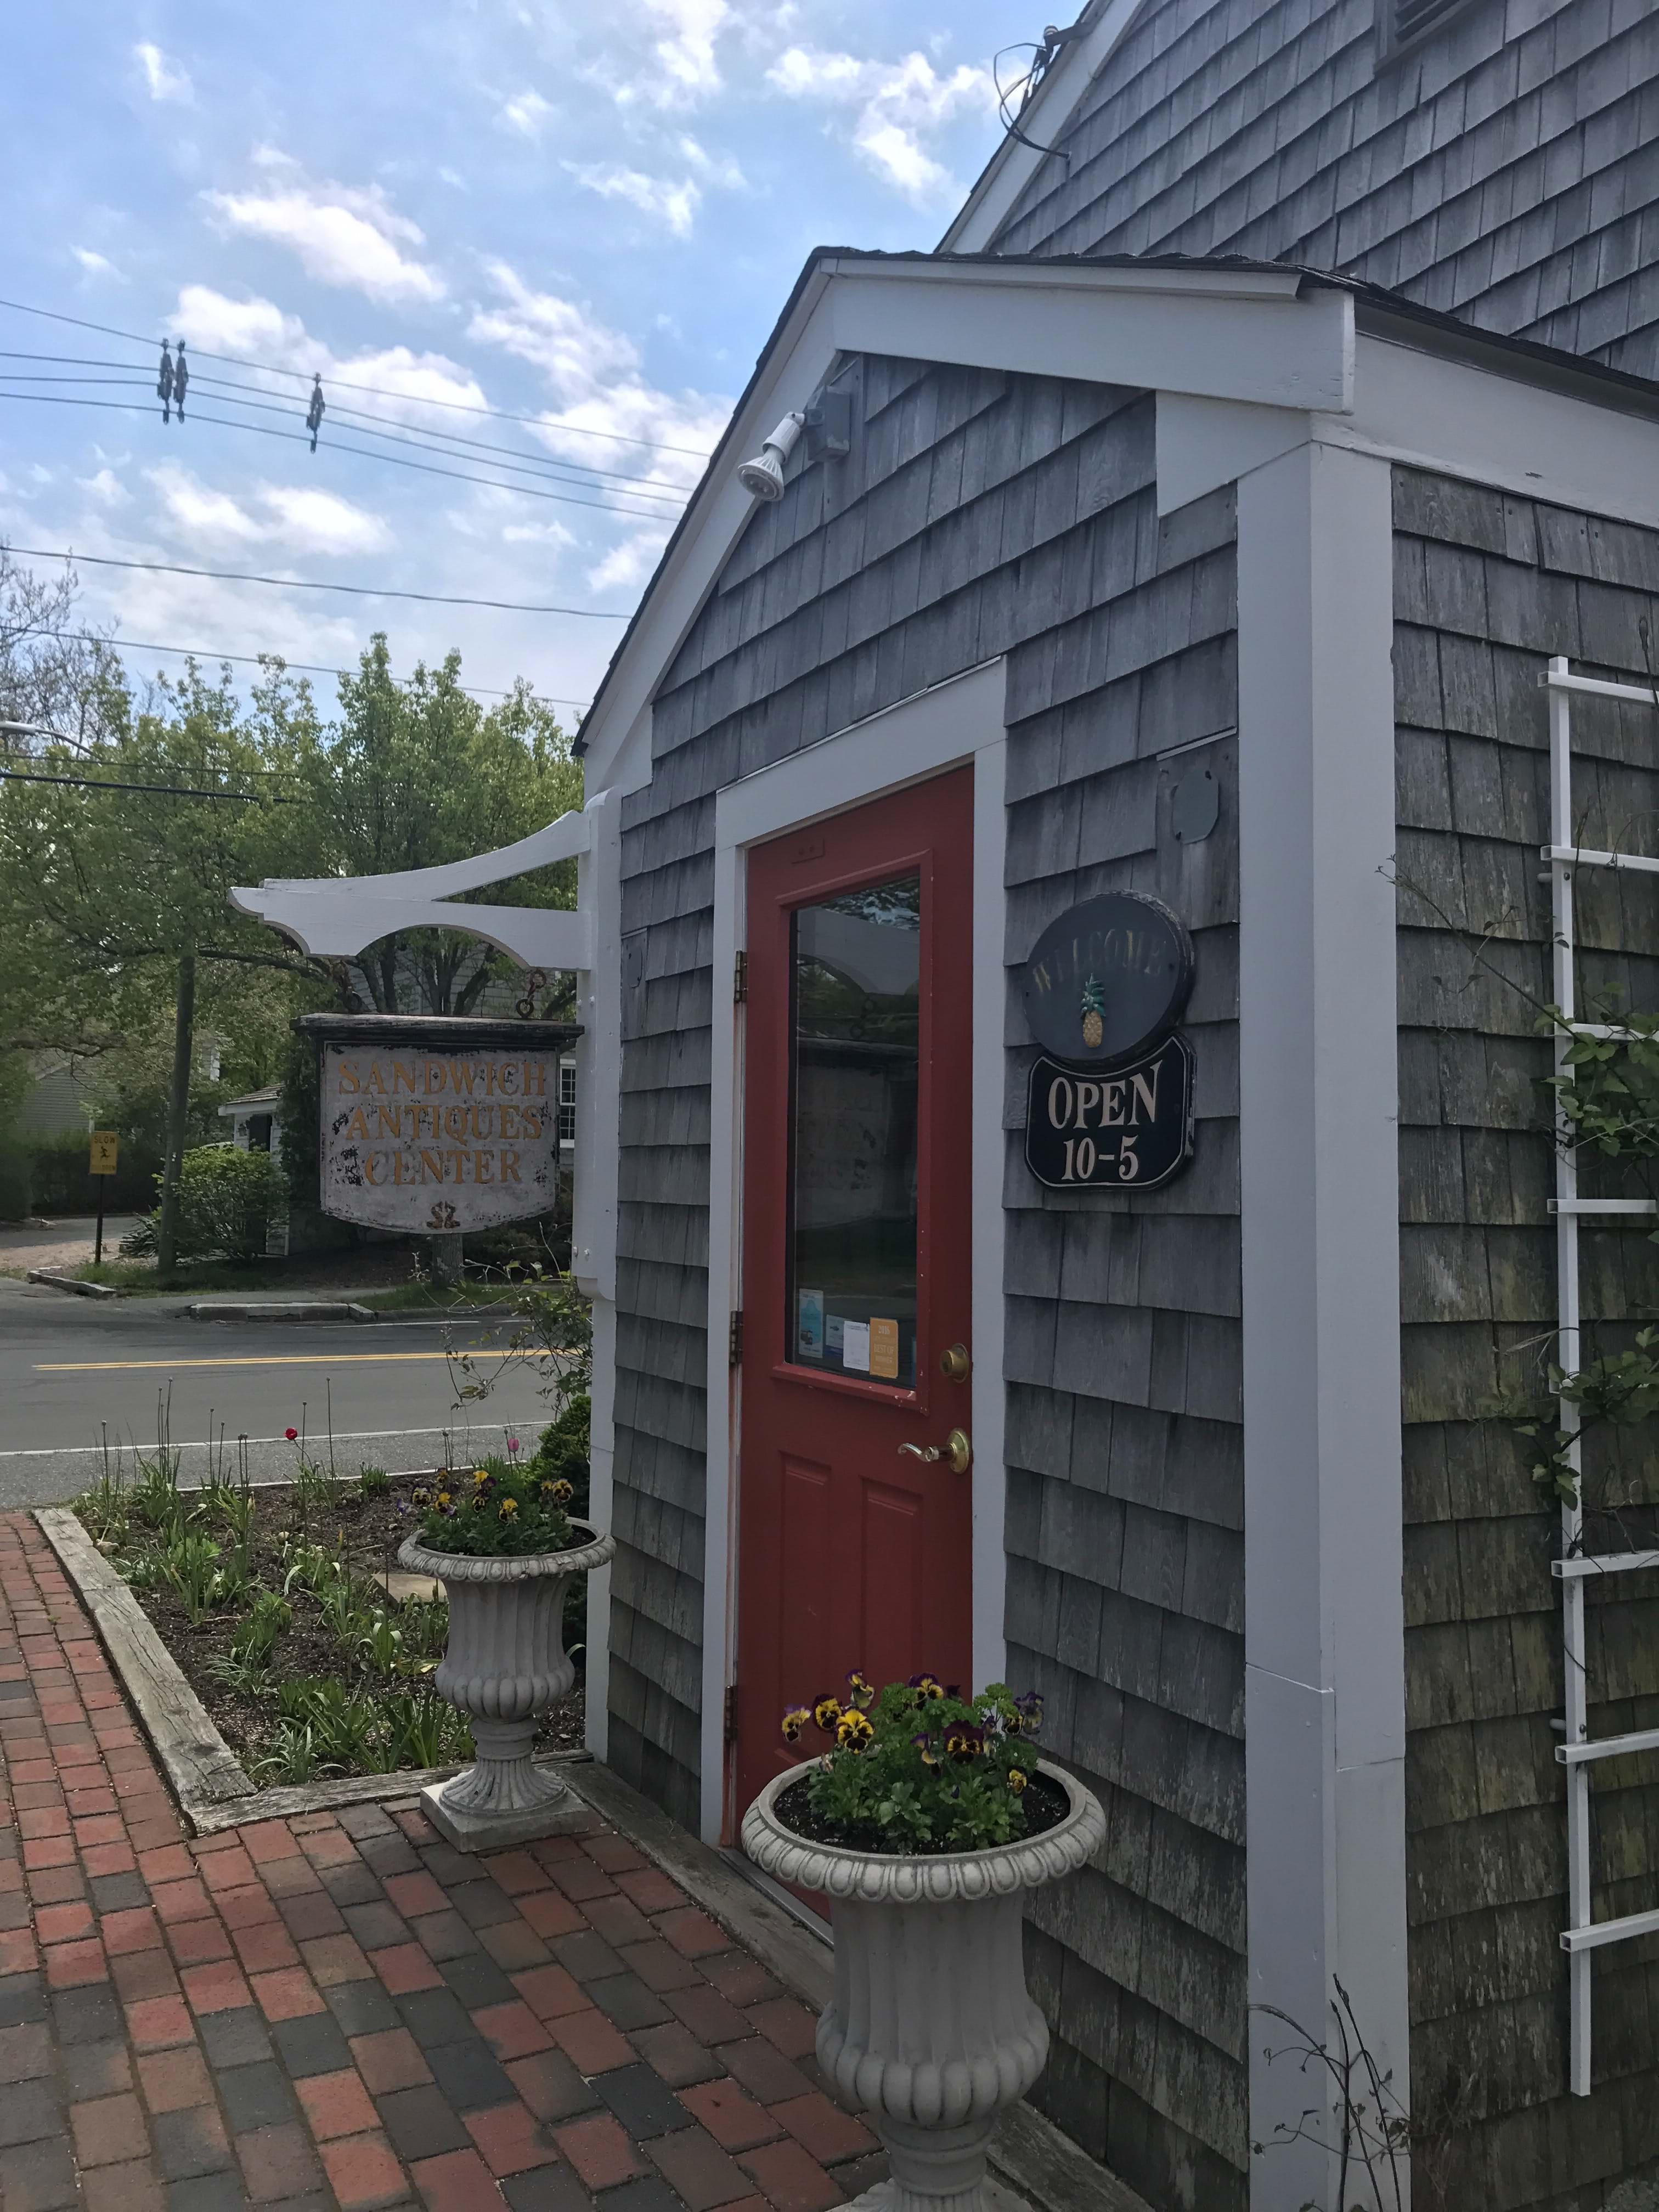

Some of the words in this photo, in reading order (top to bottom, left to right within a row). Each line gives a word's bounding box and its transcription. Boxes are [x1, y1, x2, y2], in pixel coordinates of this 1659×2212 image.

[338, 1059, 546, 1096] SANDWICH
[1048, 1060, 1163, 1130] OPEN
[94, 1136, 115, 1144] SLOW
[346, 1104, 542, 1146] ANTIQUES
[364, 1150, 522, 1186] CENTER
[1061, 1135, 1139, 1181] 10-5
